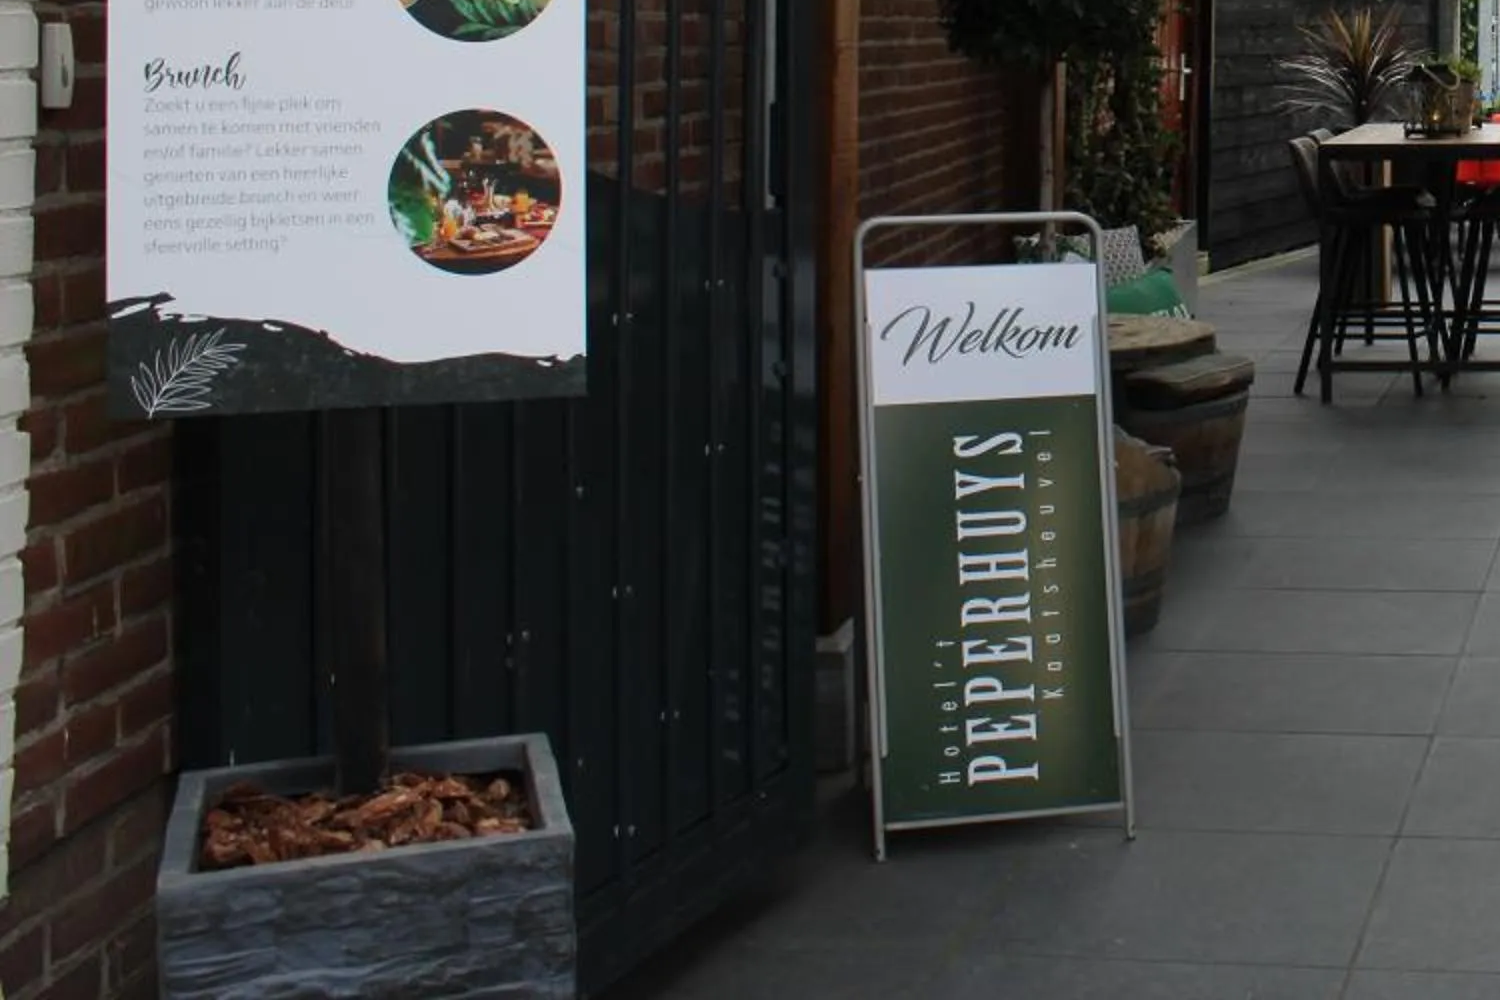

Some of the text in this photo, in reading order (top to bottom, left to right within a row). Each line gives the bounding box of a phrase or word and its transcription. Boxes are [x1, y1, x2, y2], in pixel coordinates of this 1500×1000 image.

[143, 51, 247, 93] Brunch
[880, 300, 1082, 366] Welkom
[952, 431, 1040, 787] PEPERHUYS
[1029, 429, 1065, 700] Kaatsheuvel
